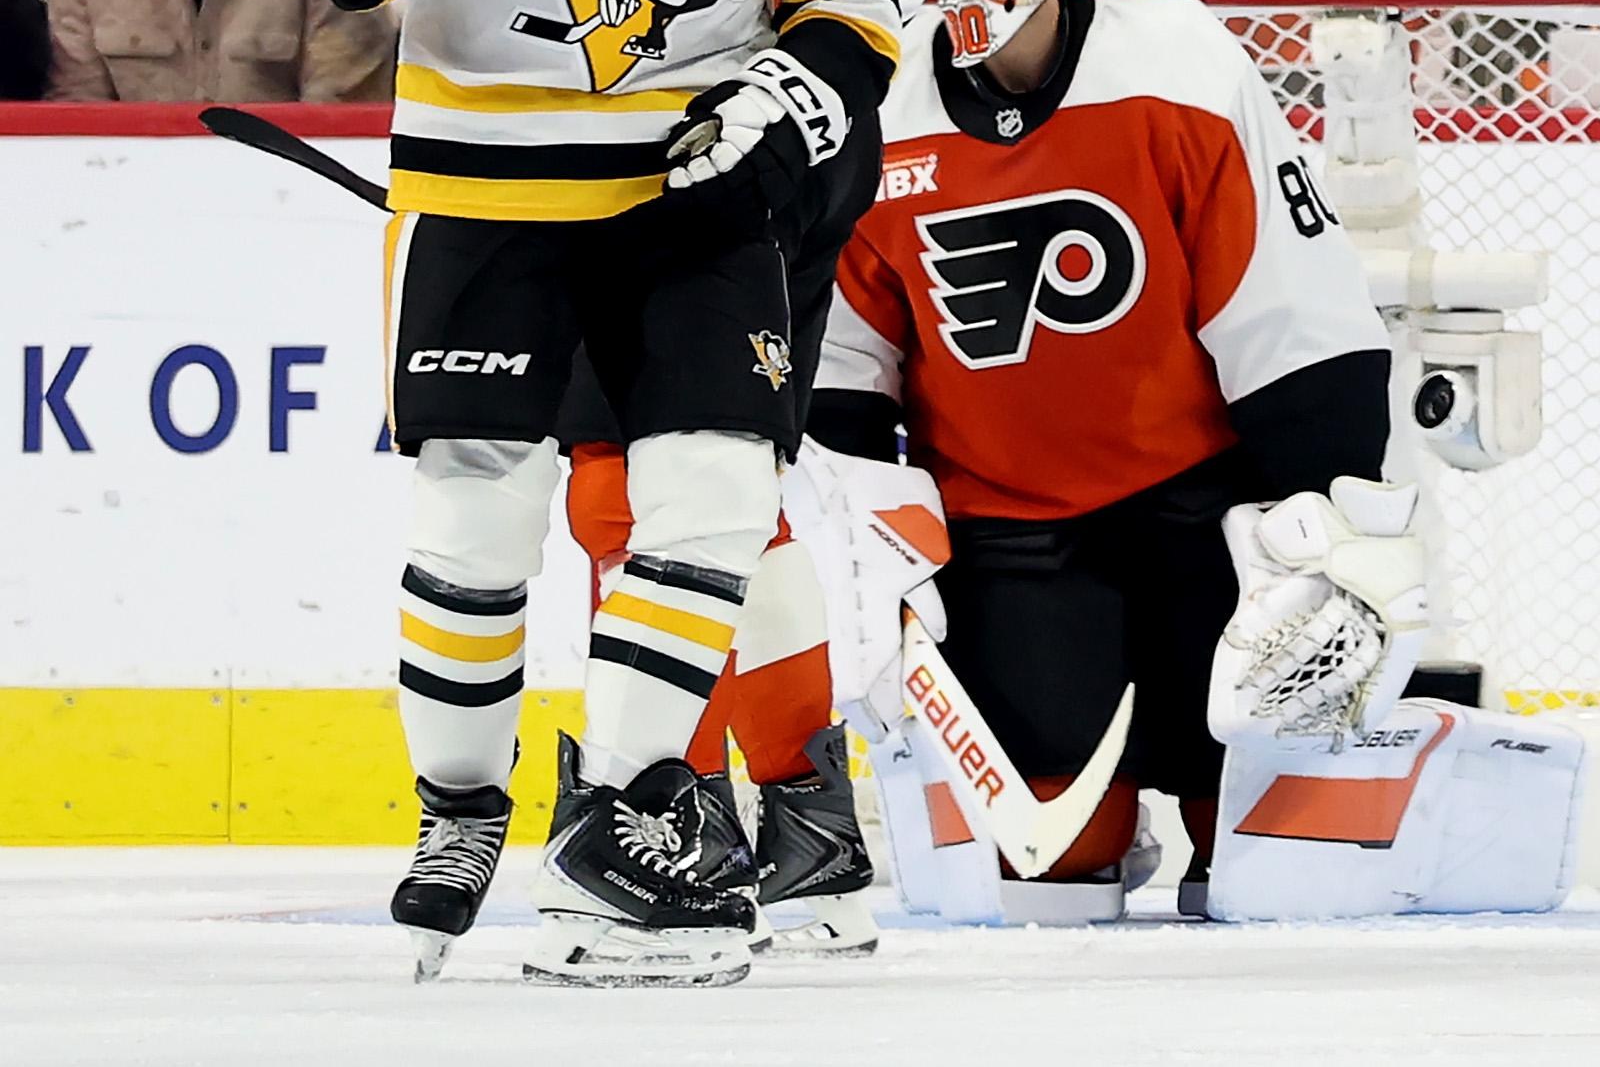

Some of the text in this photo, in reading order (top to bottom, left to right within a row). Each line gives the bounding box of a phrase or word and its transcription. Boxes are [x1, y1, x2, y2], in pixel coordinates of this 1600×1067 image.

[748, 59, 836, 155] CCM
[1276, 155, 1340, 239] 8
[23, 343, 327, 454] K OF
[406, 349, 531, 376] CCM
[905, 663, 1006, 808] BAUER
[603, 869, 659, 905] BAUER
